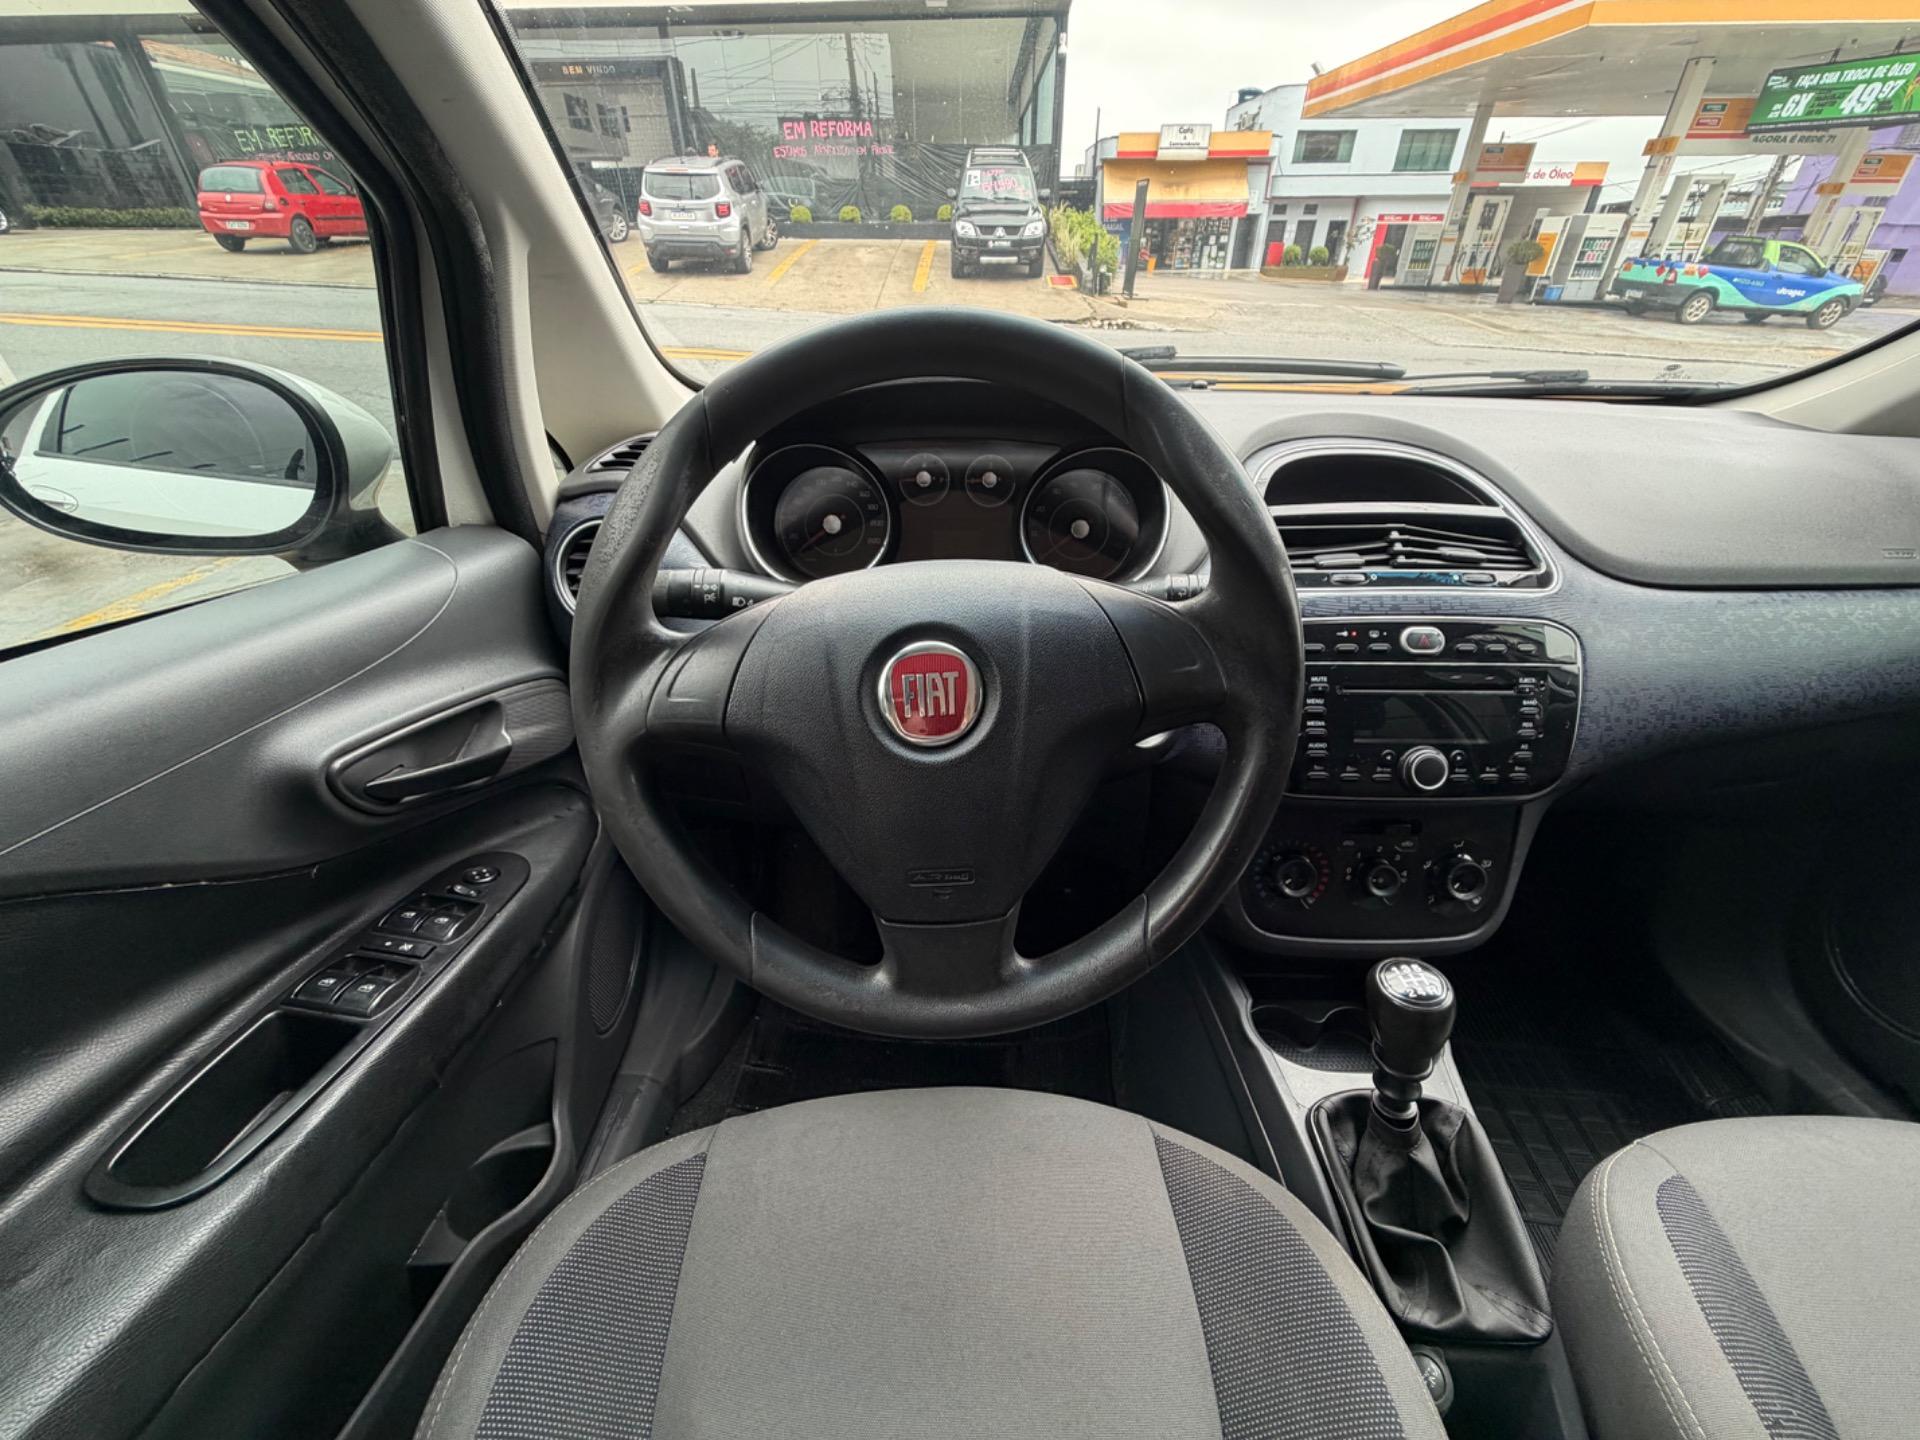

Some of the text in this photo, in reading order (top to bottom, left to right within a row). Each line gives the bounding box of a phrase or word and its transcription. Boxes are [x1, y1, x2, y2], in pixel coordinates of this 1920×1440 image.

[1840, 68, 1874, 83] TROCA
[1781, 92, 1815, 117] 6X
[783, 120, 873, 140] EM REFORMA
[1752, 135, 1787, 144] AGORA
[234, 129, 263, 152] EM
[1533, 169, 1547, 179] de
[1549, 166, 1574, 179] Óleo
[902, 671, 960, 718] FIAT
